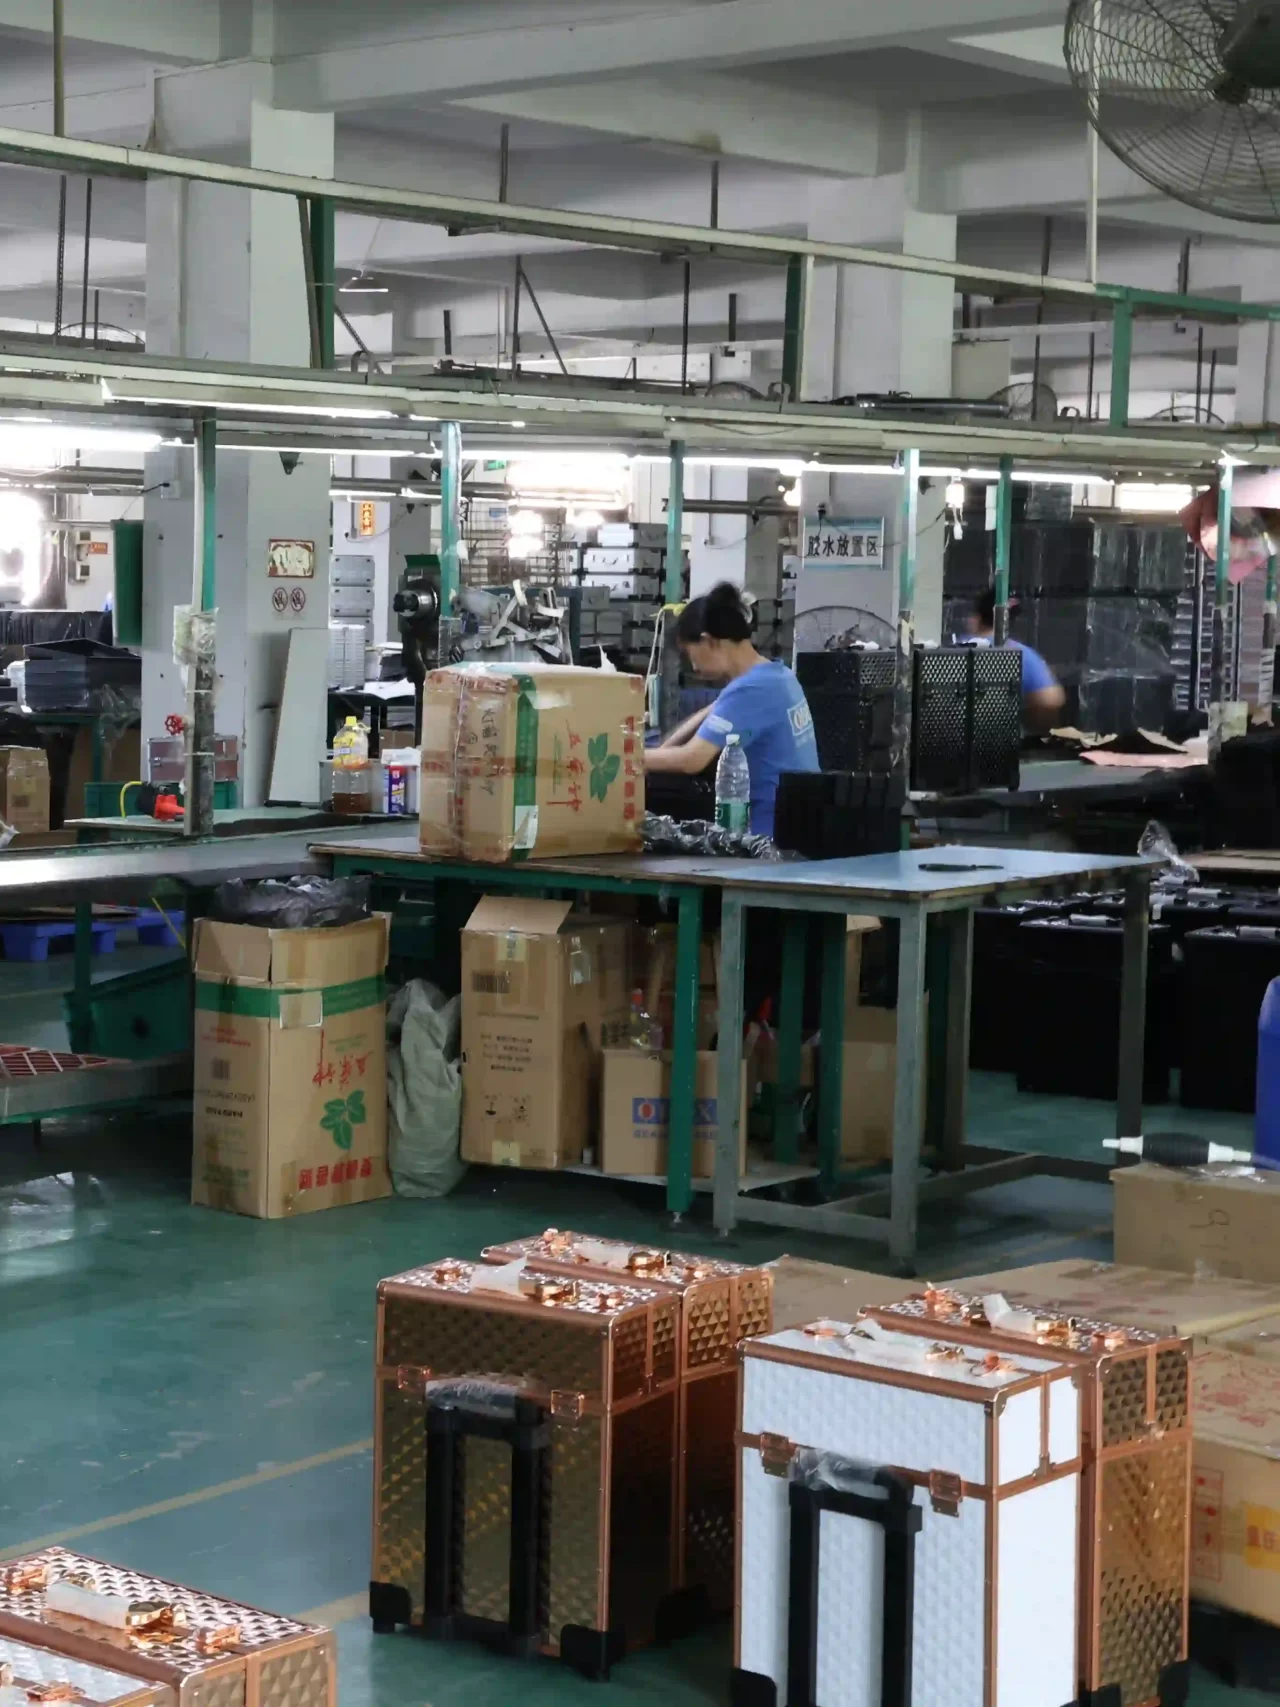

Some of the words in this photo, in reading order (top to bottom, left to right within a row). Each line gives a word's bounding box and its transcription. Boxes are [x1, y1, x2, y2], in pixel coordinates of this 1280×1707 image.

[807, 534, 880, 558] 胶水放置区
